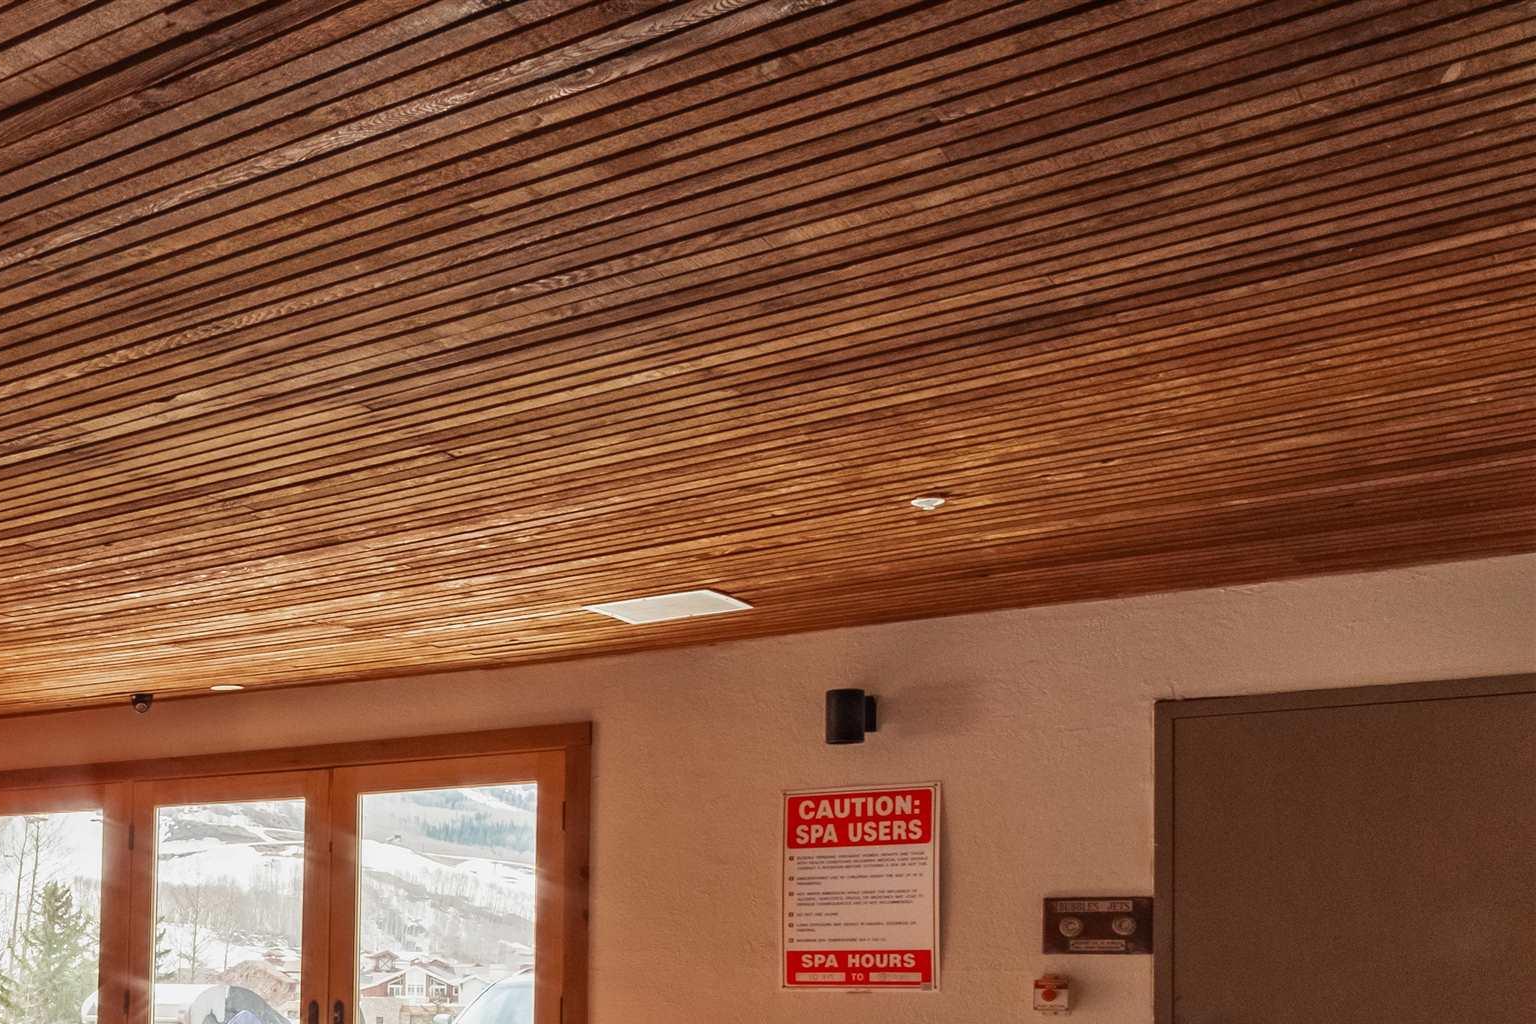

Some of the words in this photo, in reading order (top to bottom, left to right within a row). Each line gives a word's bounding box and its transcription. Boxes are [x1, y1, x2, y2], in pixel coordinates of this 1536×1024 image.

[798, 795, 920, 820] CAUTION:
[795, 824, 838, 844] SPA
[848, 820, 922, 842] USERS
[801, 954, 838, 968] SPA
[848, 953, 916, 967] HOURS
[851, 973, 864, 981] TO
